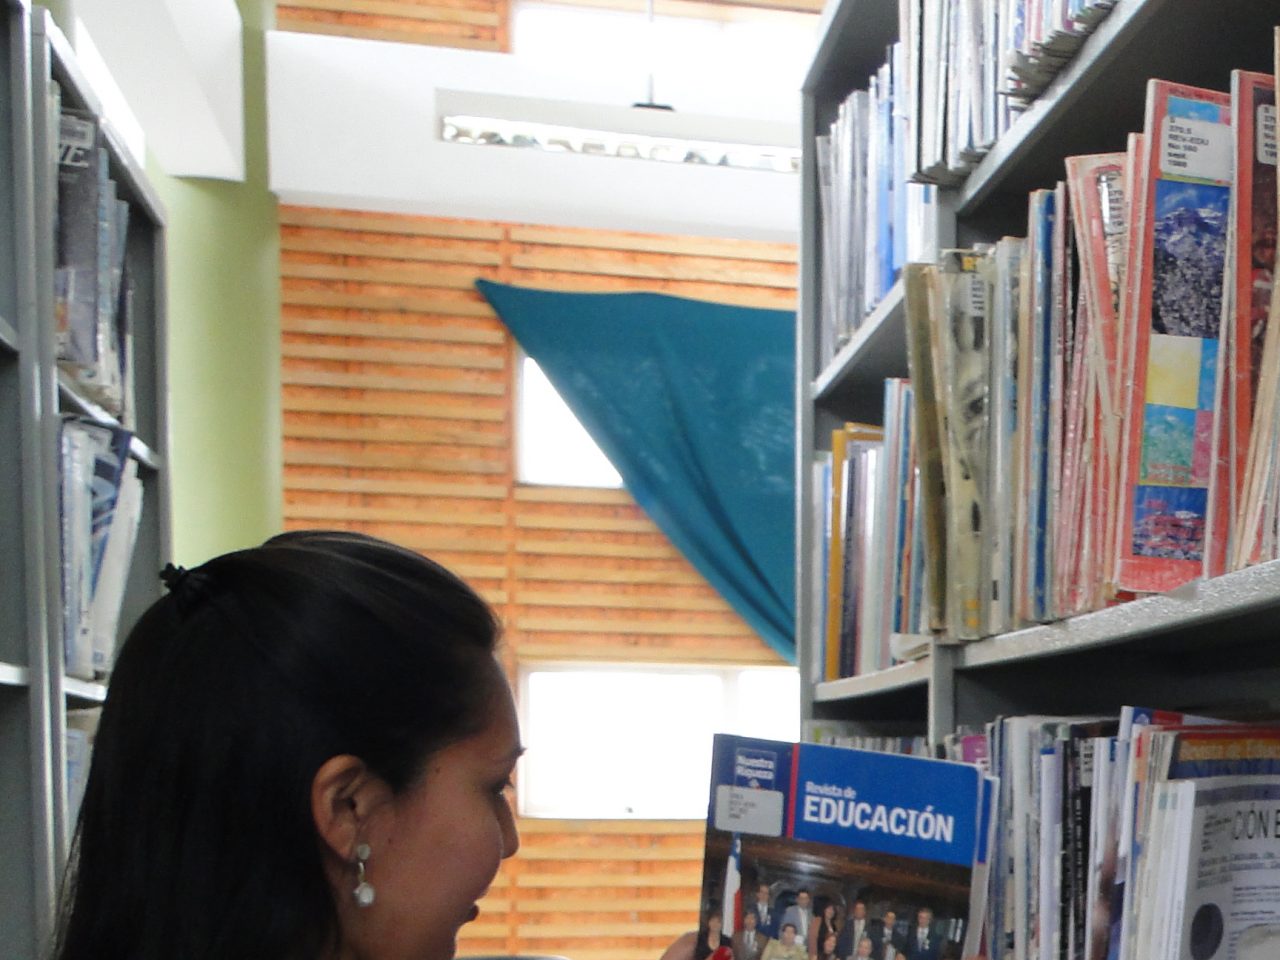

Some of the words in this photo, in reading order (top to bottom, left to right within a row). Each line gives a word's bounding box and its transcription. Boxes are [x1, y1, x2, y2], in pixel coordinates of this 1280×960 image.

[805, 781, 842, 798] Revista
[843, 786, 857, 799] de
[803, 795, 955, 843] EDUCACIÓN
